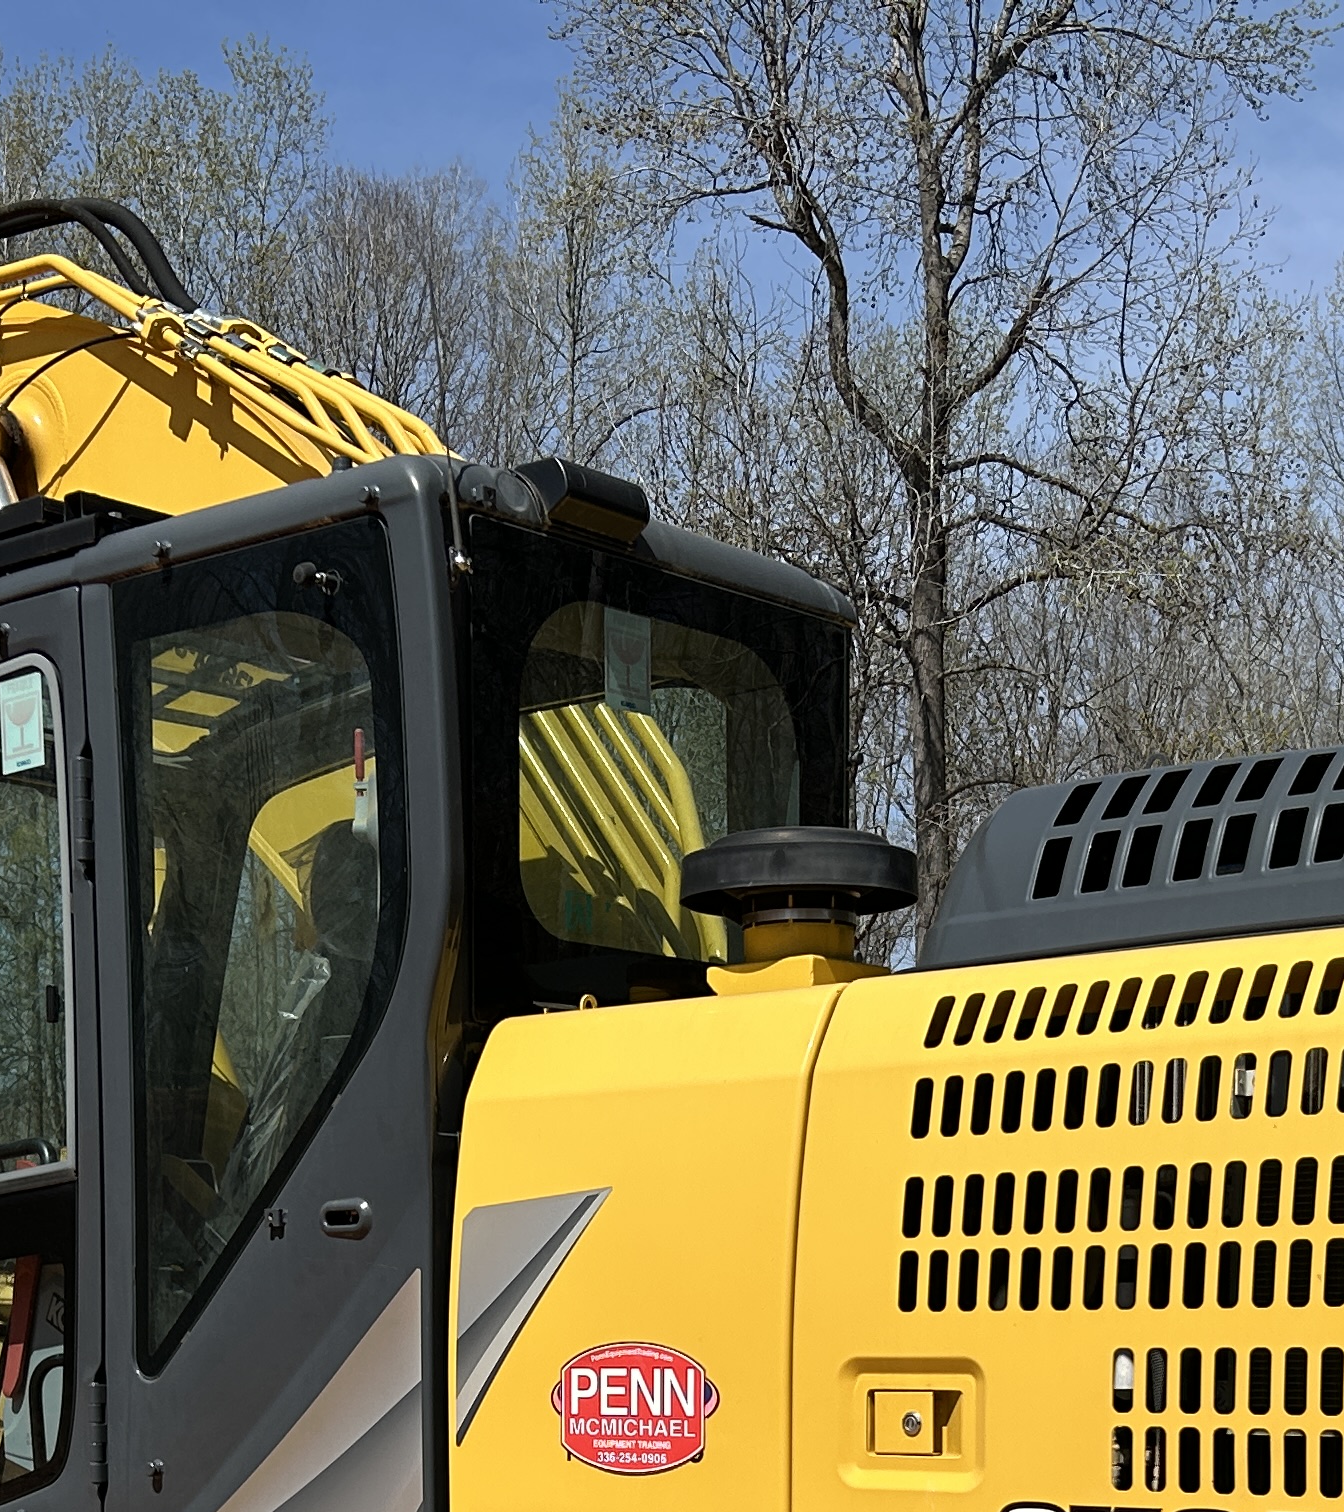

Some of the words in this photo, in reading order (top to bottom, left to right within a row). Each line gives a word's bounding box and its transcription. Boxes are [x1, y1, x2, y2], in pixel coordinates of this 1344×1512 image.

[569, 1367, 695, 1417] PENN
[569, 1418, 696, 1438] MCMICHAEL
[593, 1439, 636, 1449] EQUIPMENT
[637, 1441, 672, 1450] TRADING
